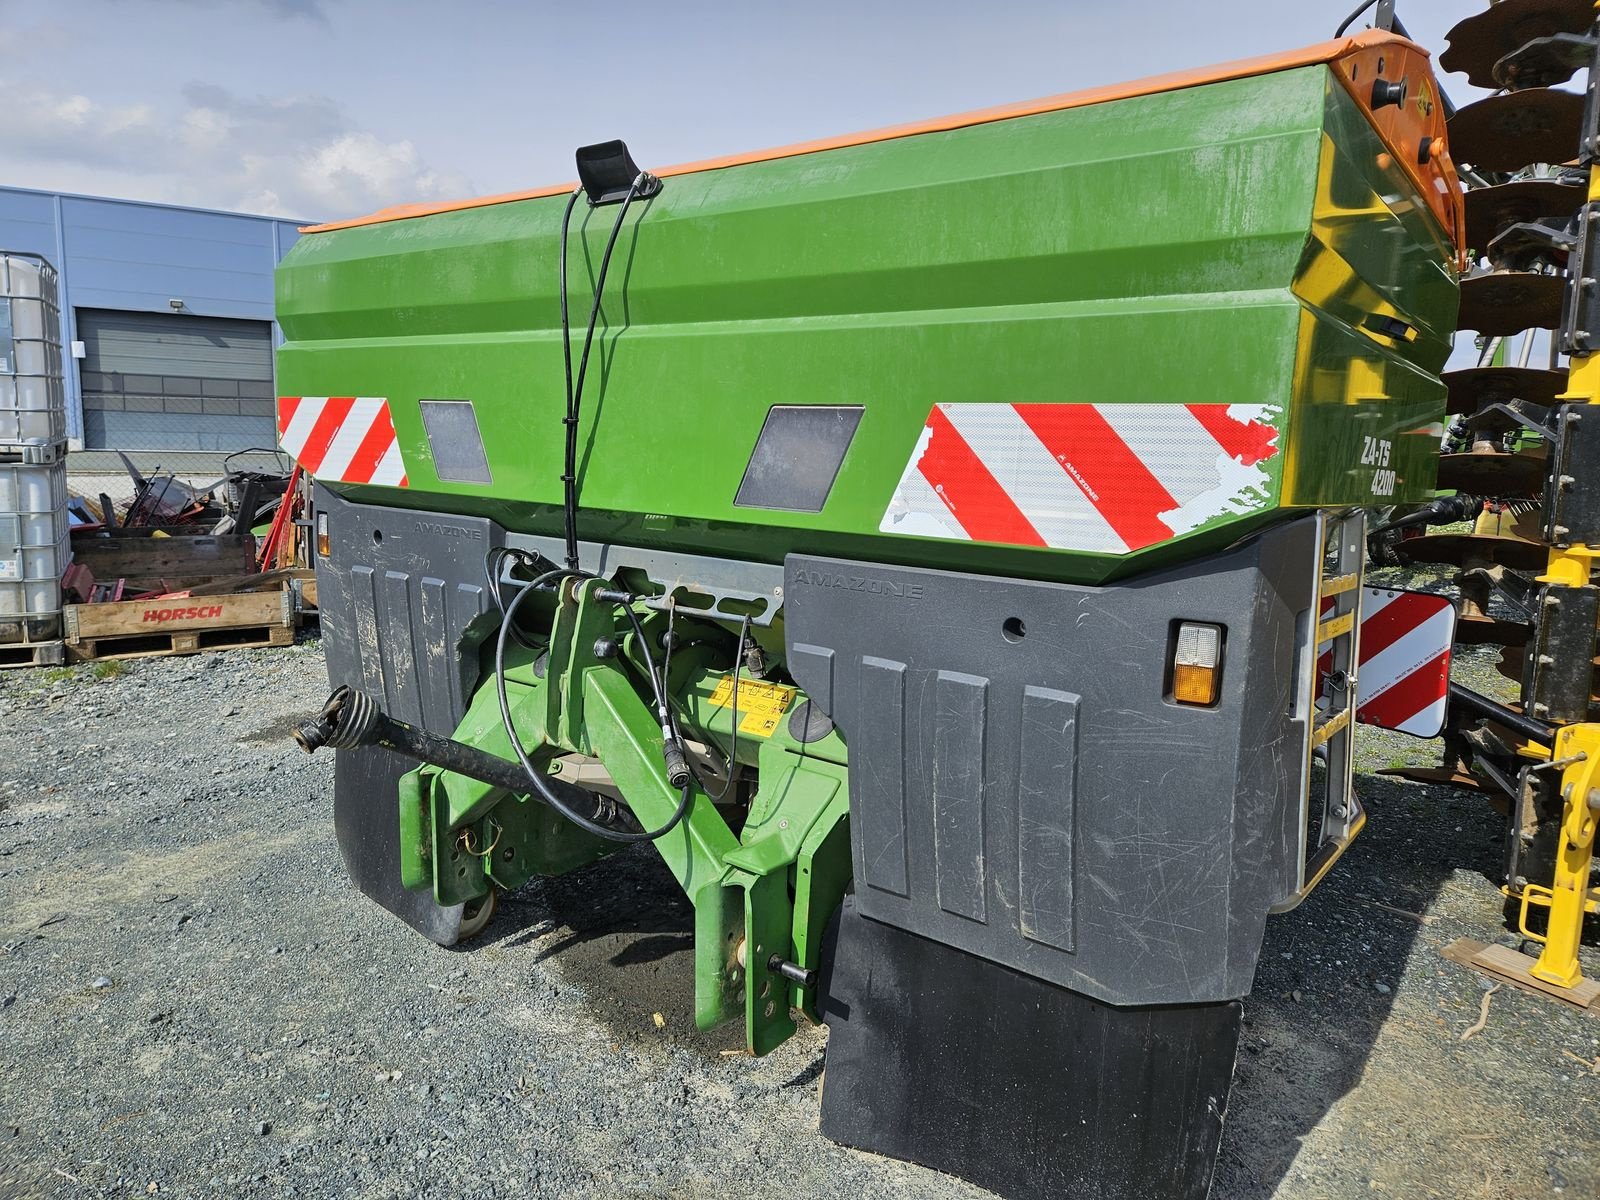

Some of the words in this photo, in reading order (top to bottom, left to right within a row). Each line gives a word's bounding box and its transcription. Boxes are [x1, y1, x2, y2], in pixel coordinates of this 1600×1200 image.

[1360, 435, 1391, 467] ZA-TS
[1065, 462, 1100, 501] AMAZONE
[1370, 468, 1396, 496] 4200
[414, 521, 481, 540] AMAZONE
[794, 569, 923, 599] AMAZONE
[143, 605, 223, 623] HORSCH
